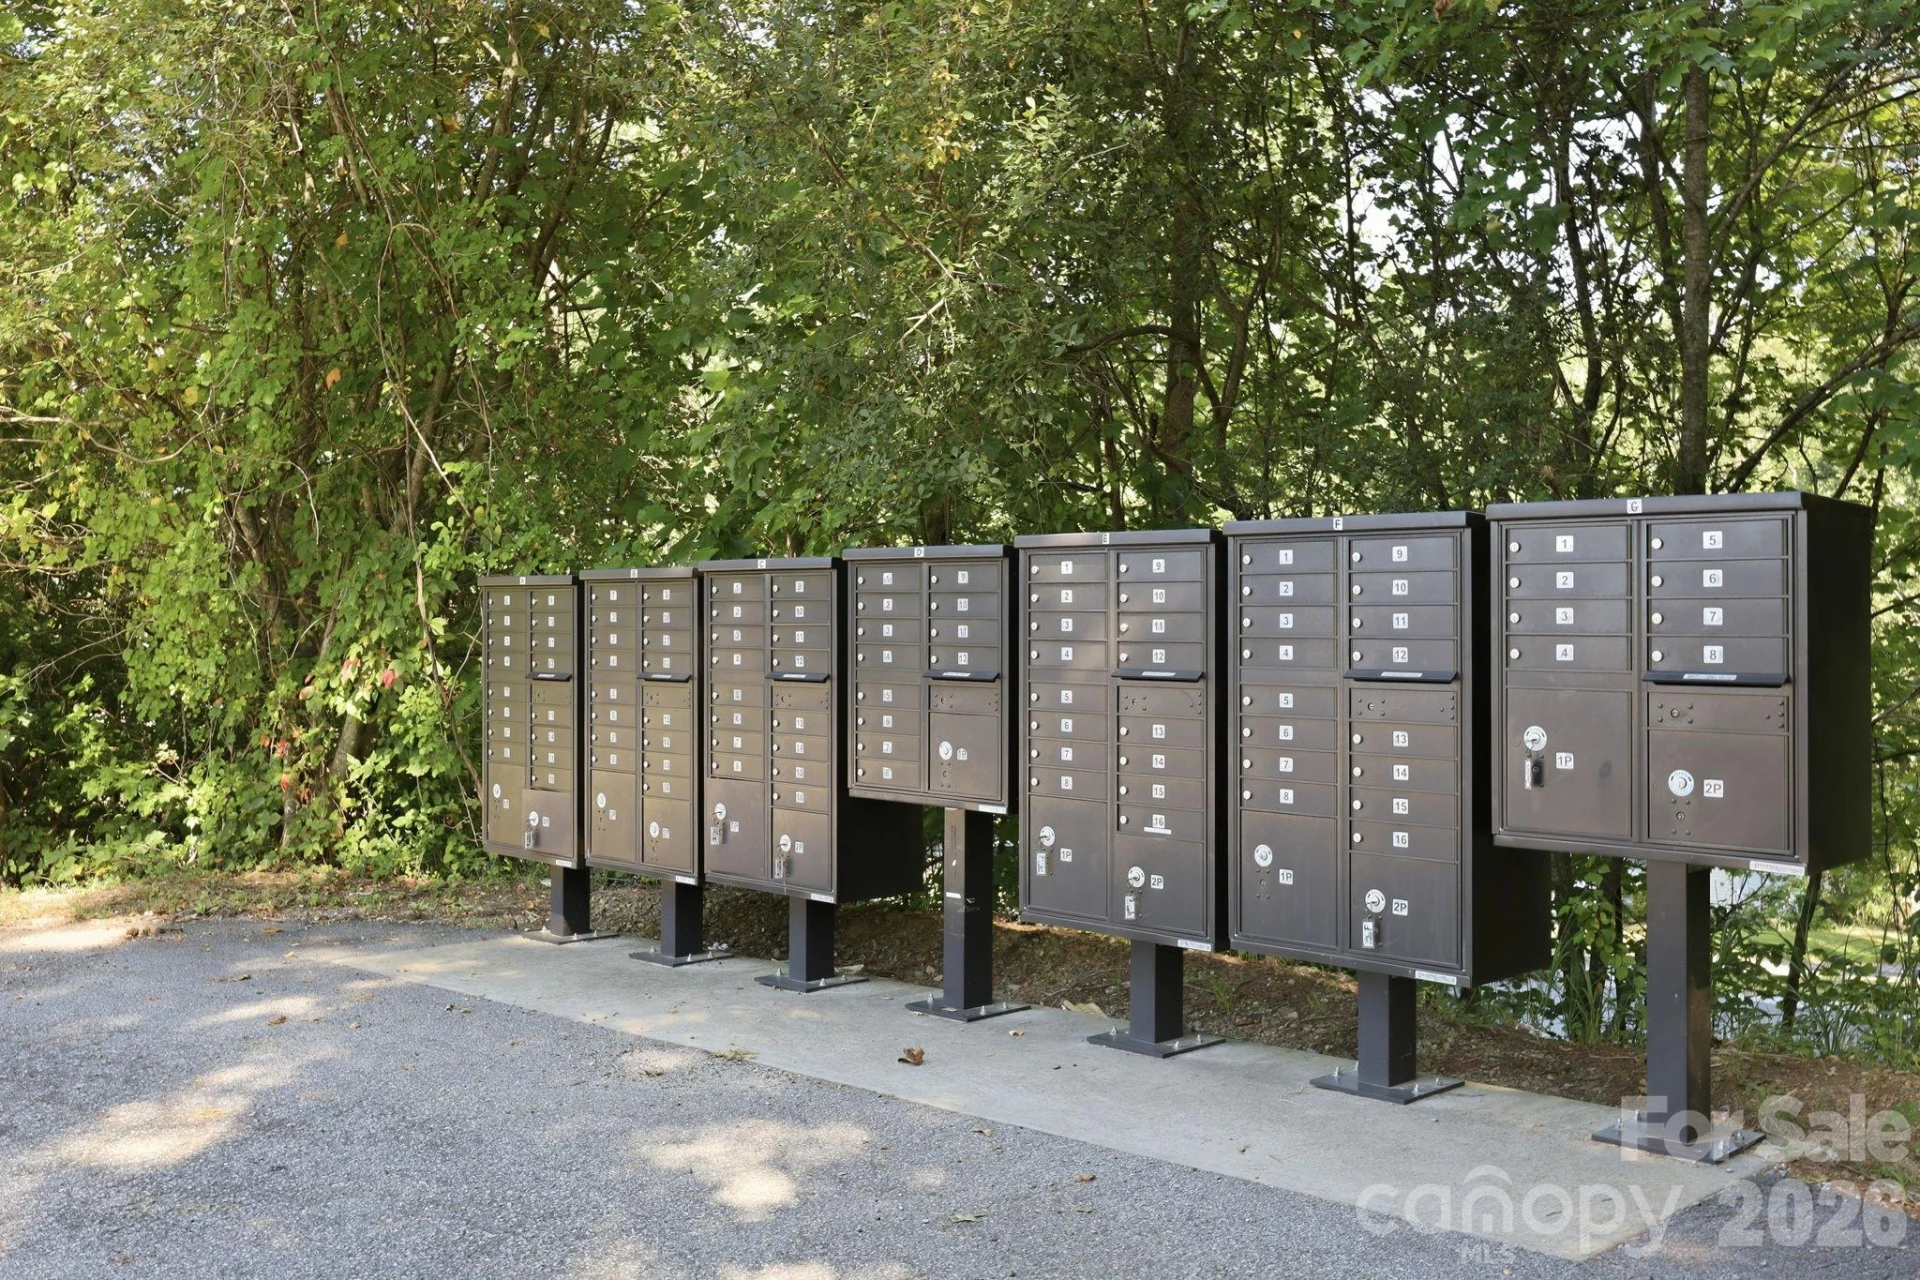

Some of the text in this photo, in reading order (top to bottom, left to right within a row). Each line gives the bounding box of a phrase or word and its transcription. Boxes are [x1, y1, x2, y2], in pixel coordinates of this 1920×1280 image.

[1631, 501, 1639, 512] G
[1335, 519, 1340, 529] F
[1562, 539, 1567, 549] 1
[1709, 535, 1717, 546] 5
[1396, 549, 1403, 559] 9
[1156, 562, 1161, 570] 9
[1562, 575, 1568, 586] 2
[1709, 573, 1717, 584] 6
[1283, 584, 1289, 594] 2
[1395, 582, 1406, 592] 10
[1064, 592, 1069, 601] 2
[1155, 591, 1164, 601] 10
[959, 600, 967, 609] 10
[1283, 616, 1289, 626] 3
[1395, 616, 1405, 626] 11
[1561, 611, 1568, 622] 3
[1710, 611, 1716, 622] 7
[1065, 621, 1069, 630] 3
[1154, 621, 1163, 631] 11
[960, 627, 967, 636] 11
[1064, 650, 1069, 658] 4
[1154, 651, 1164, 661] 12
[1283, 648, 1289, 657] 4
[1394, 650, 1406, 660] 12
[1561, 648, 1568, 658] 4
[1709, 650, 1717, 660] 8
[959, 654, 967, 663] 12
[1064, 693, 1069, 701] 5
[1284, 696, 1289, 705] 5
[1064, 721, 1069, 730] 6
[1154, 727, 1164, 736] 13
[1283, 728, 1289, 738] 6
[1395, 734, 1407, 744] 13
[958, 750, 967, 759] 1P
[1064, 749, 1069, 758] 7
[1154, 757, 1164, 766] 14
[1284, 760, 1289, 769] 7
[1558, 756, 1572, 766] 1P
[1396, 768, 1407, 777] 14
[1064, 778, 1069, 787] 8
[1154, 787, 1164, 796] 15
[1705, 783, 1722, 794] 2P
[1283, 791, 1289, 801] 8
[1395, 801, 1407, 812] 15
[1154, 817, 1164, 826] 16
[1396, 835, 1407, 845] 16
[1062, 850, 1071, 859] 1P
[1152, 877, 1163, 886] 2P
[1281, 872, 1292, 881] 1P
[1394, 902, 1407, 912] 2P
